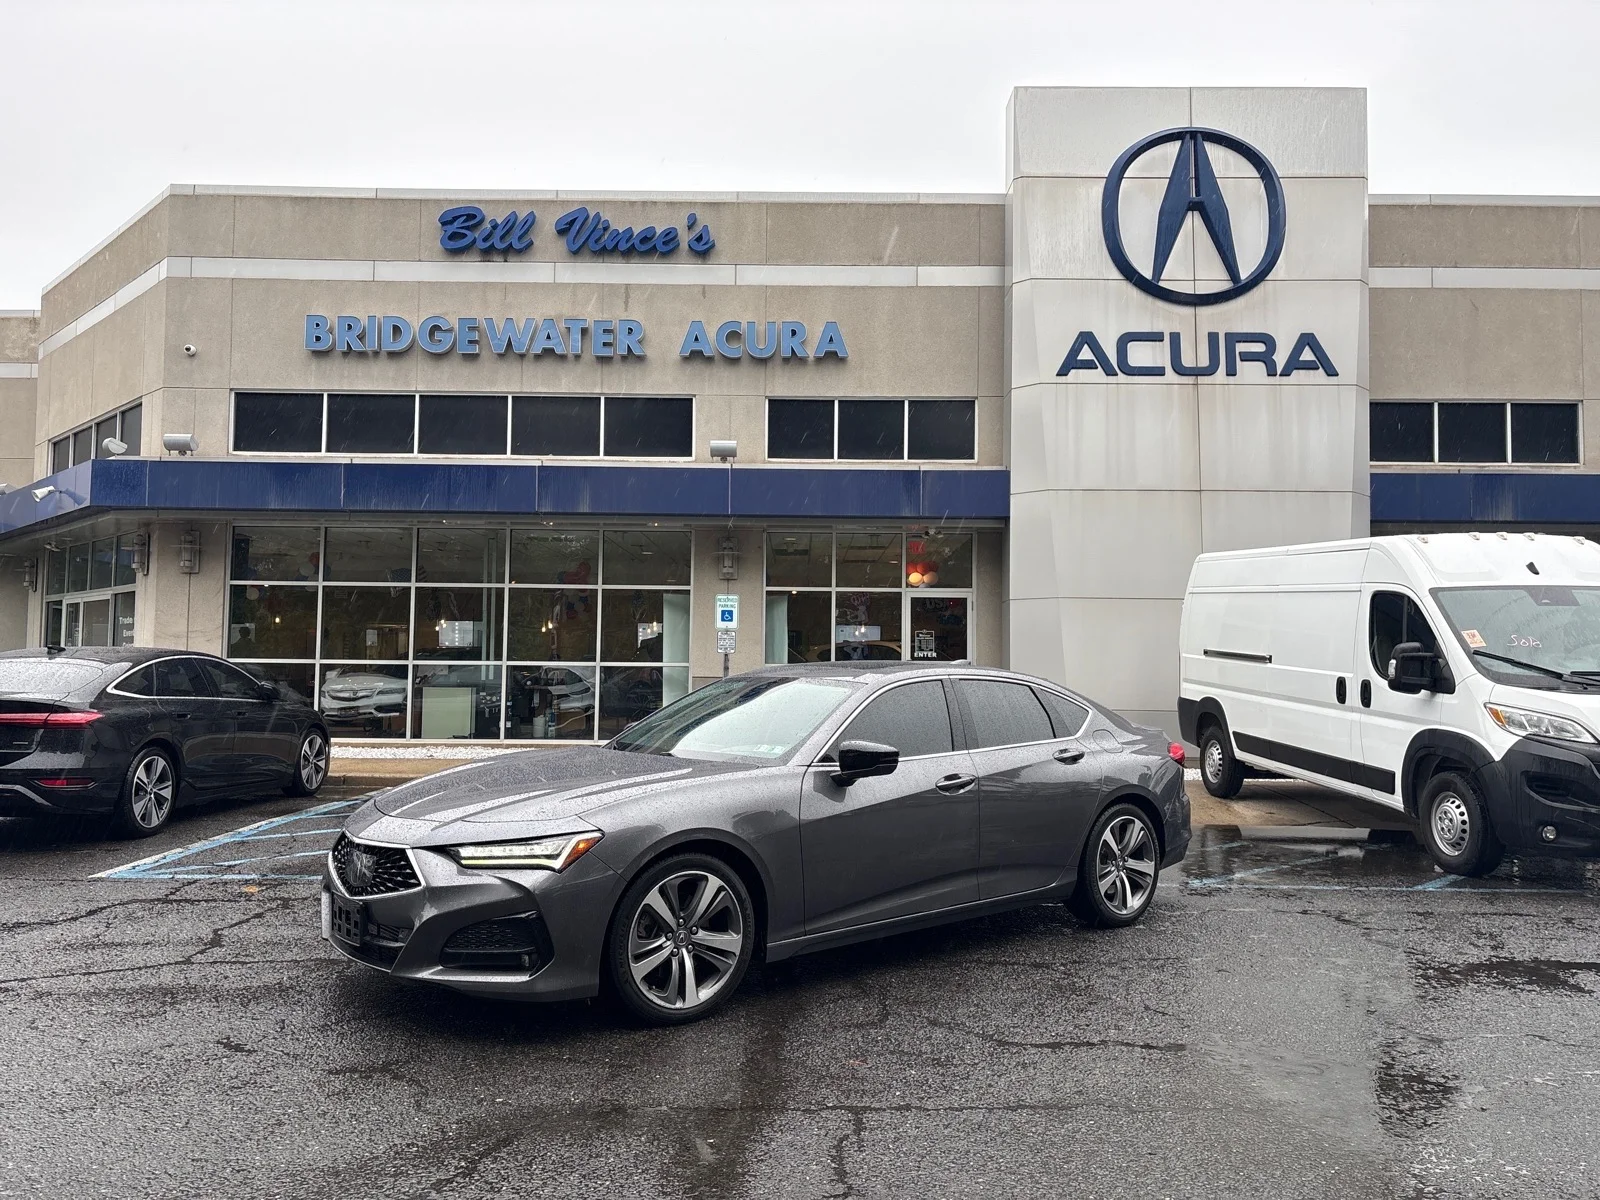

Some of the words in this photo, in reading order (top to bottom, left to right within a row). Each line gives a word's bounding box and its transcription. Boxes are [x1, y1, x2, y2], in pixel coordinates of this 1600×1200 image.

[438, 205, 536, 252] Bill
[555, 206, 715, 255] Vince's
[304, 314, 646, 357] BRIDGEWATER
[680, 320, 849, 359] ACURA
[1056, 331, 1339, 377] ACURA
[119, 616, 133, 625] Trade
